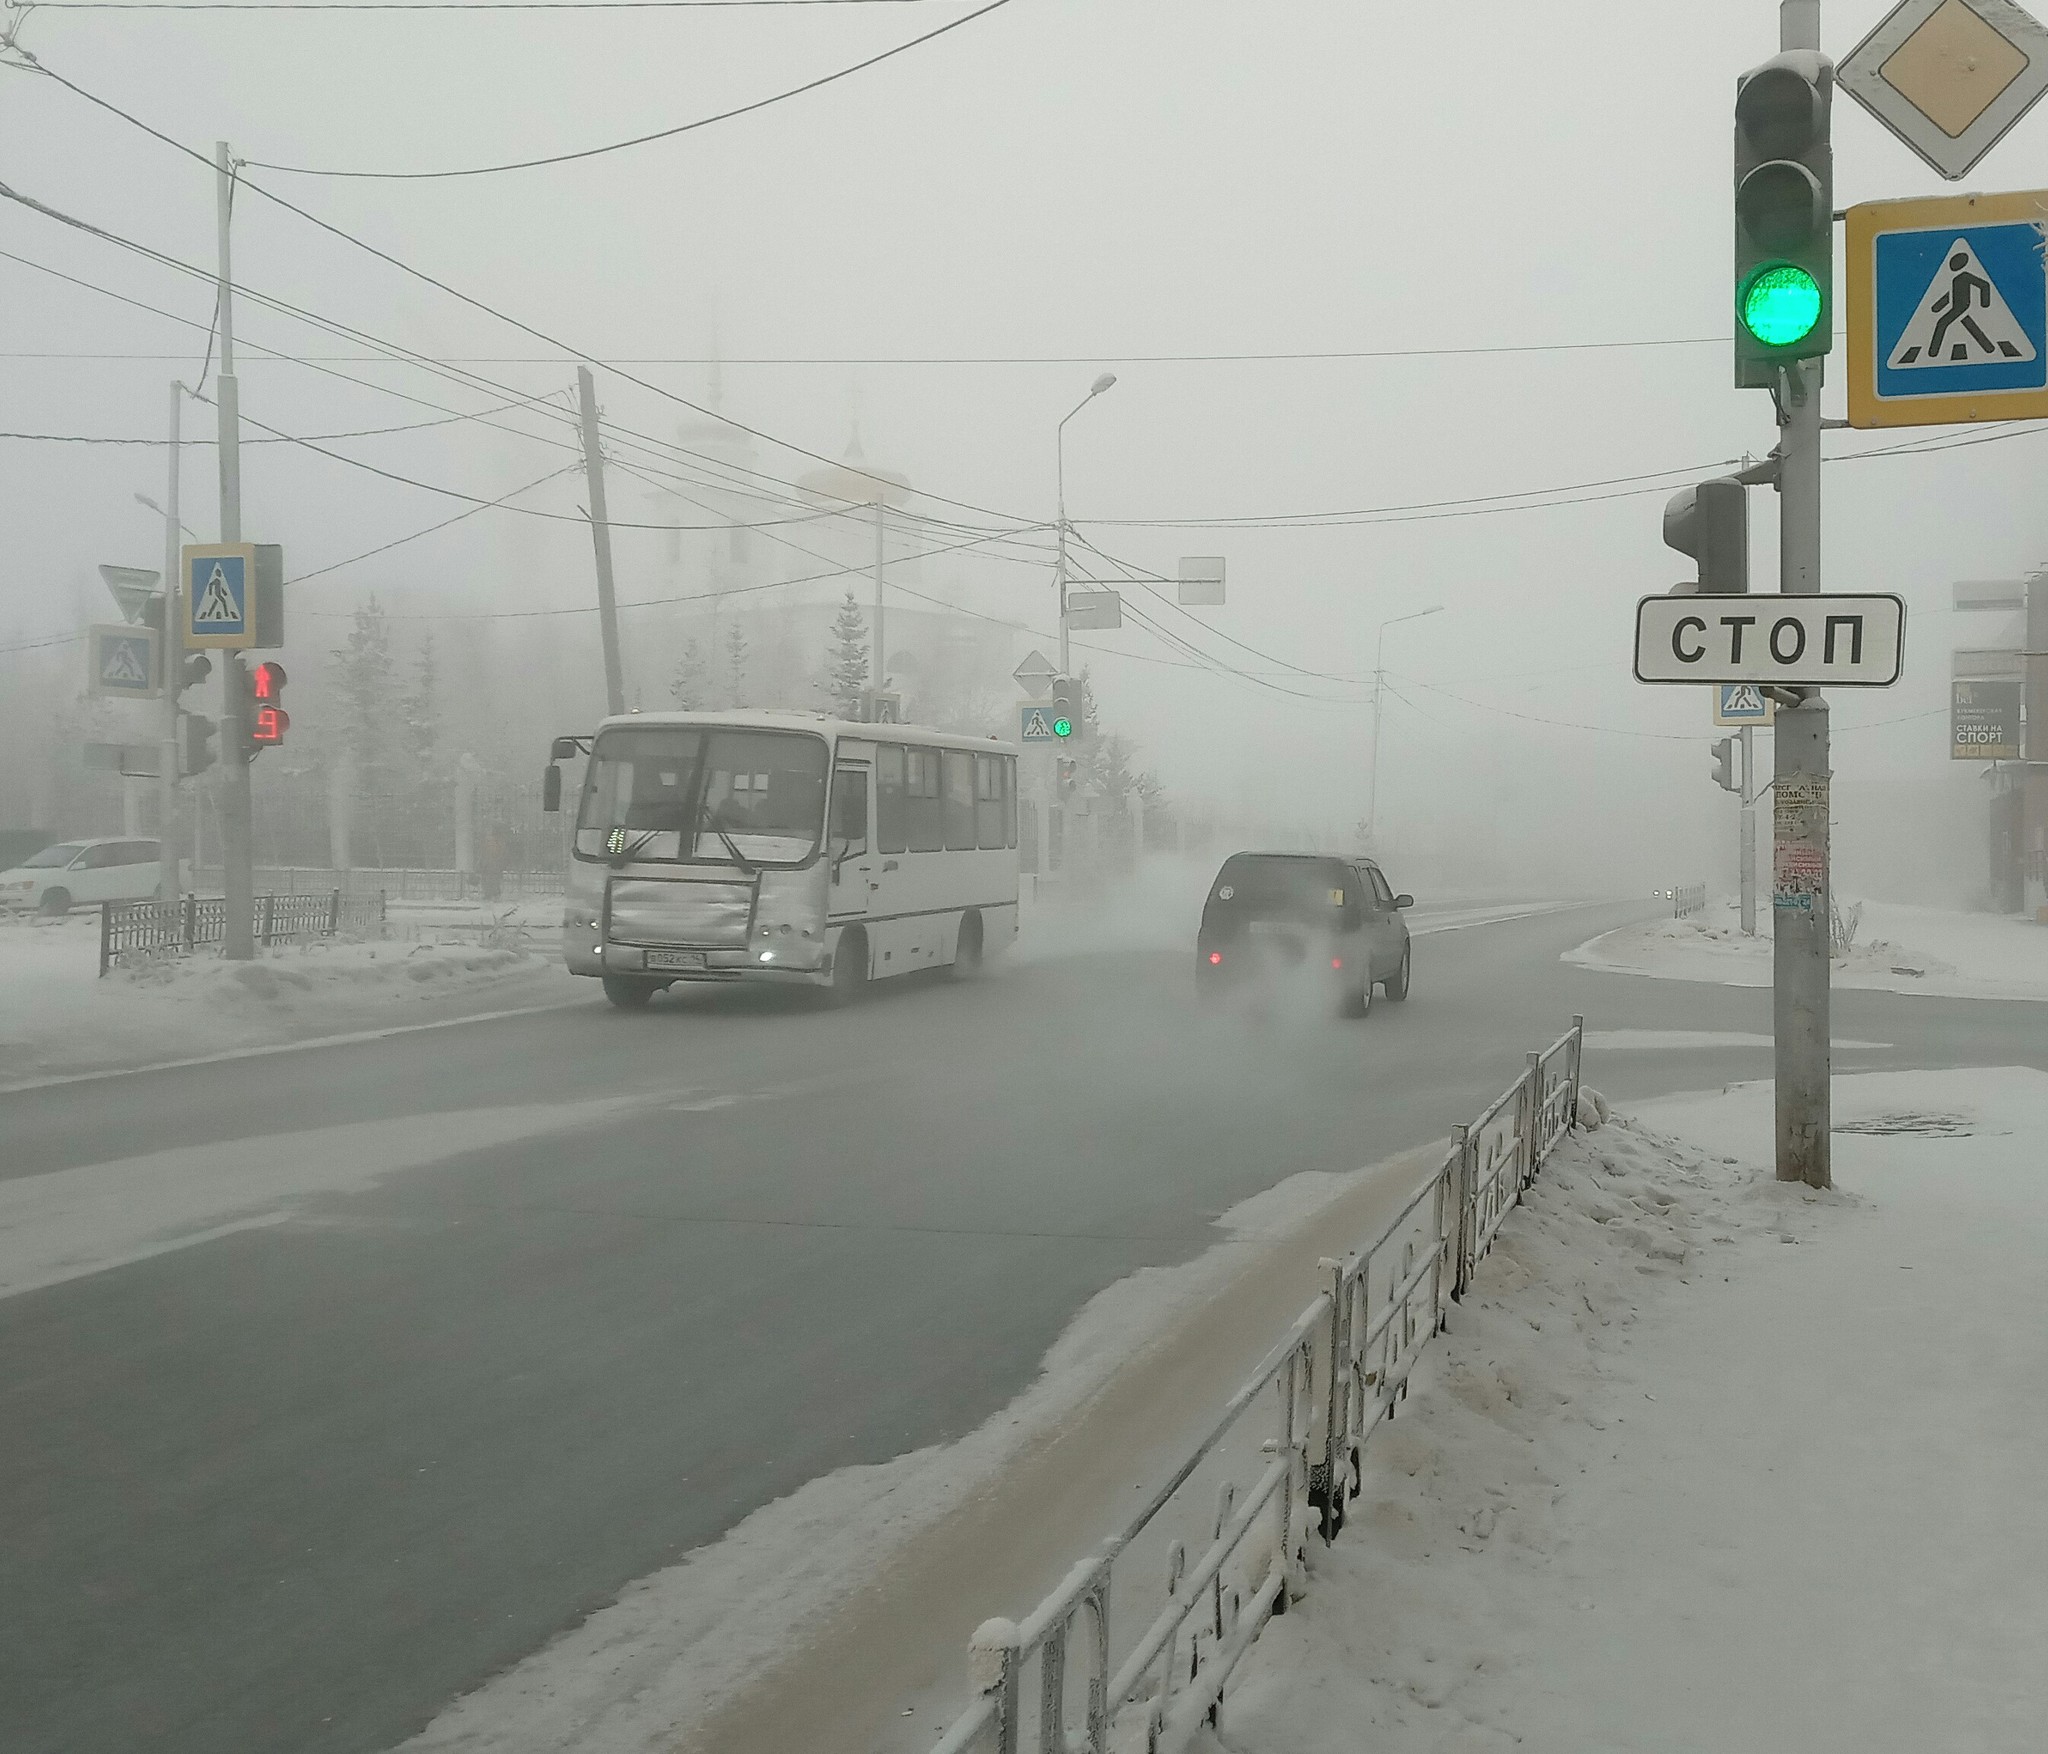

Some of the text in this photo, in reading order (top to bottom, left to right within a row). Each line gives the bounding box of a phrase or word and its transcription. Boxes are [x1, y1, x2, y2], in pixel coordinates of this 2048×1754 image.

[1671, 615, 1864, 665] СТОП
[252, 710, 278, 738] 9
[1956, 724, 2003, 732] СТАВКИ НА
[1956, 732, 2003, 743] СПОРТ
